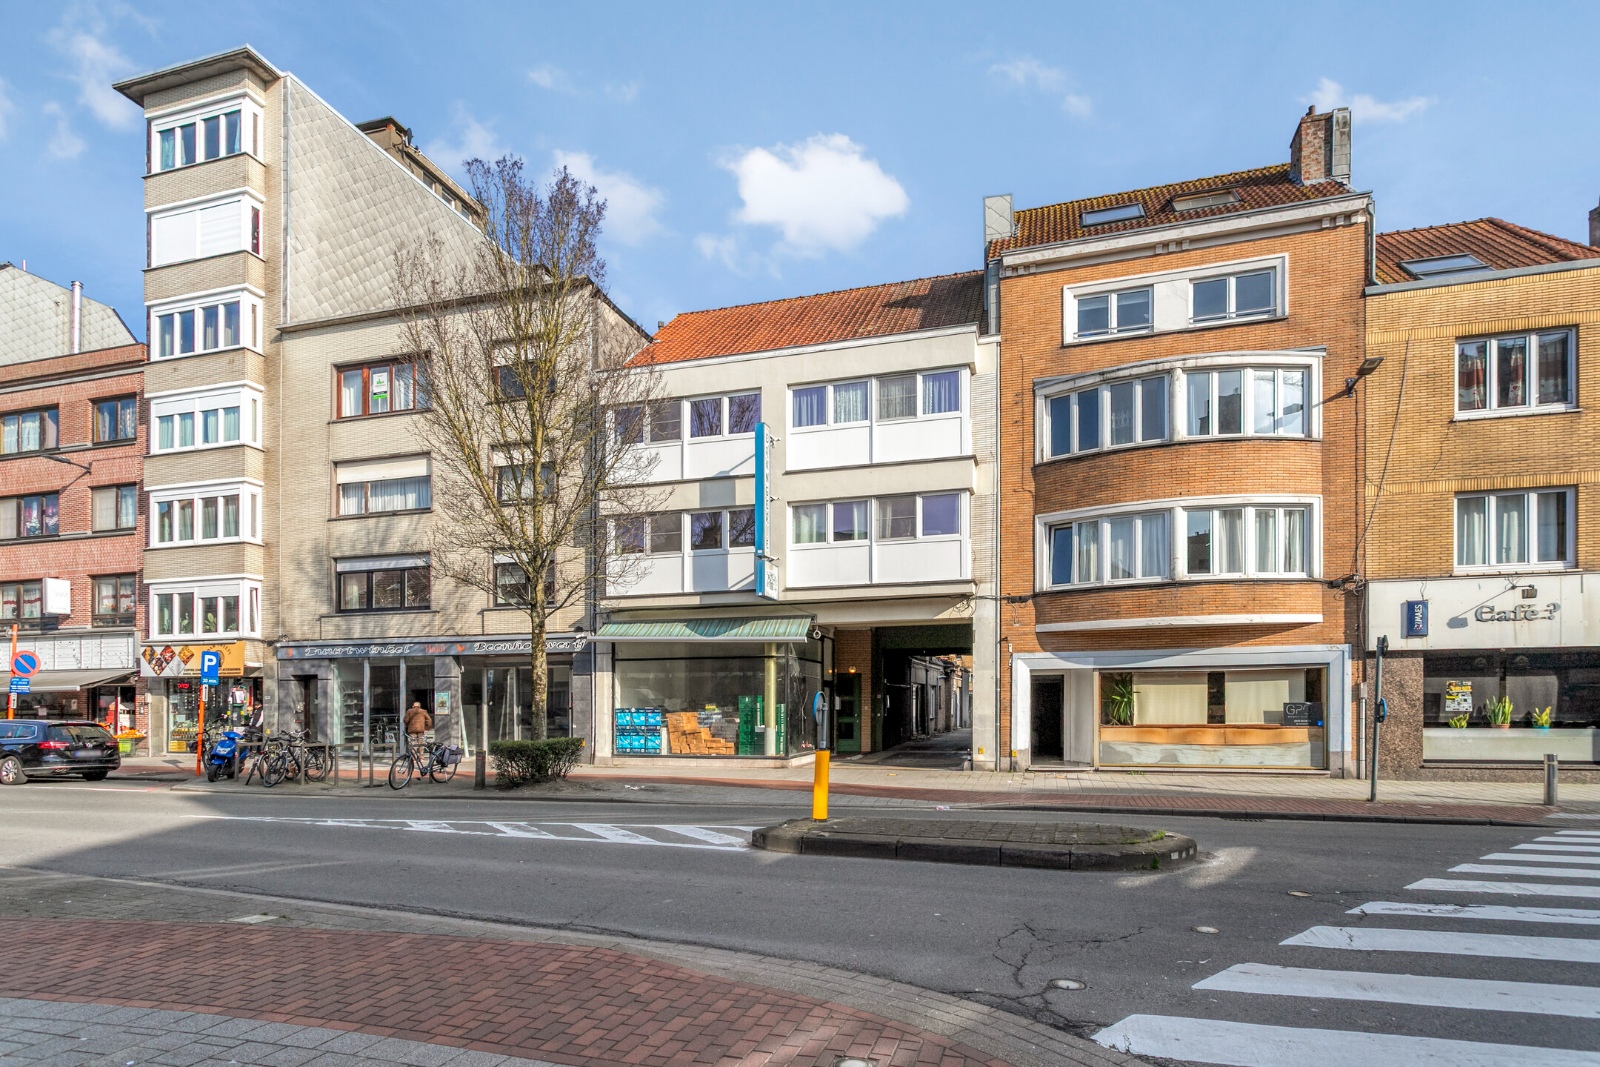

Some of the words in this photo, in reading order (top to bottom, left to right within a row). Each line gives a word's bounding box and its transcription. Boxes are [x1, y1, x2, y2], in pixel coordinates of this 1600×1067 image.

[1415, 604, 1423, 622] MAES
[1475, 603, 1539, 622] Café
[473, 638, 587, 652] Beenhowerij
[203, 655, 217, 673] P
